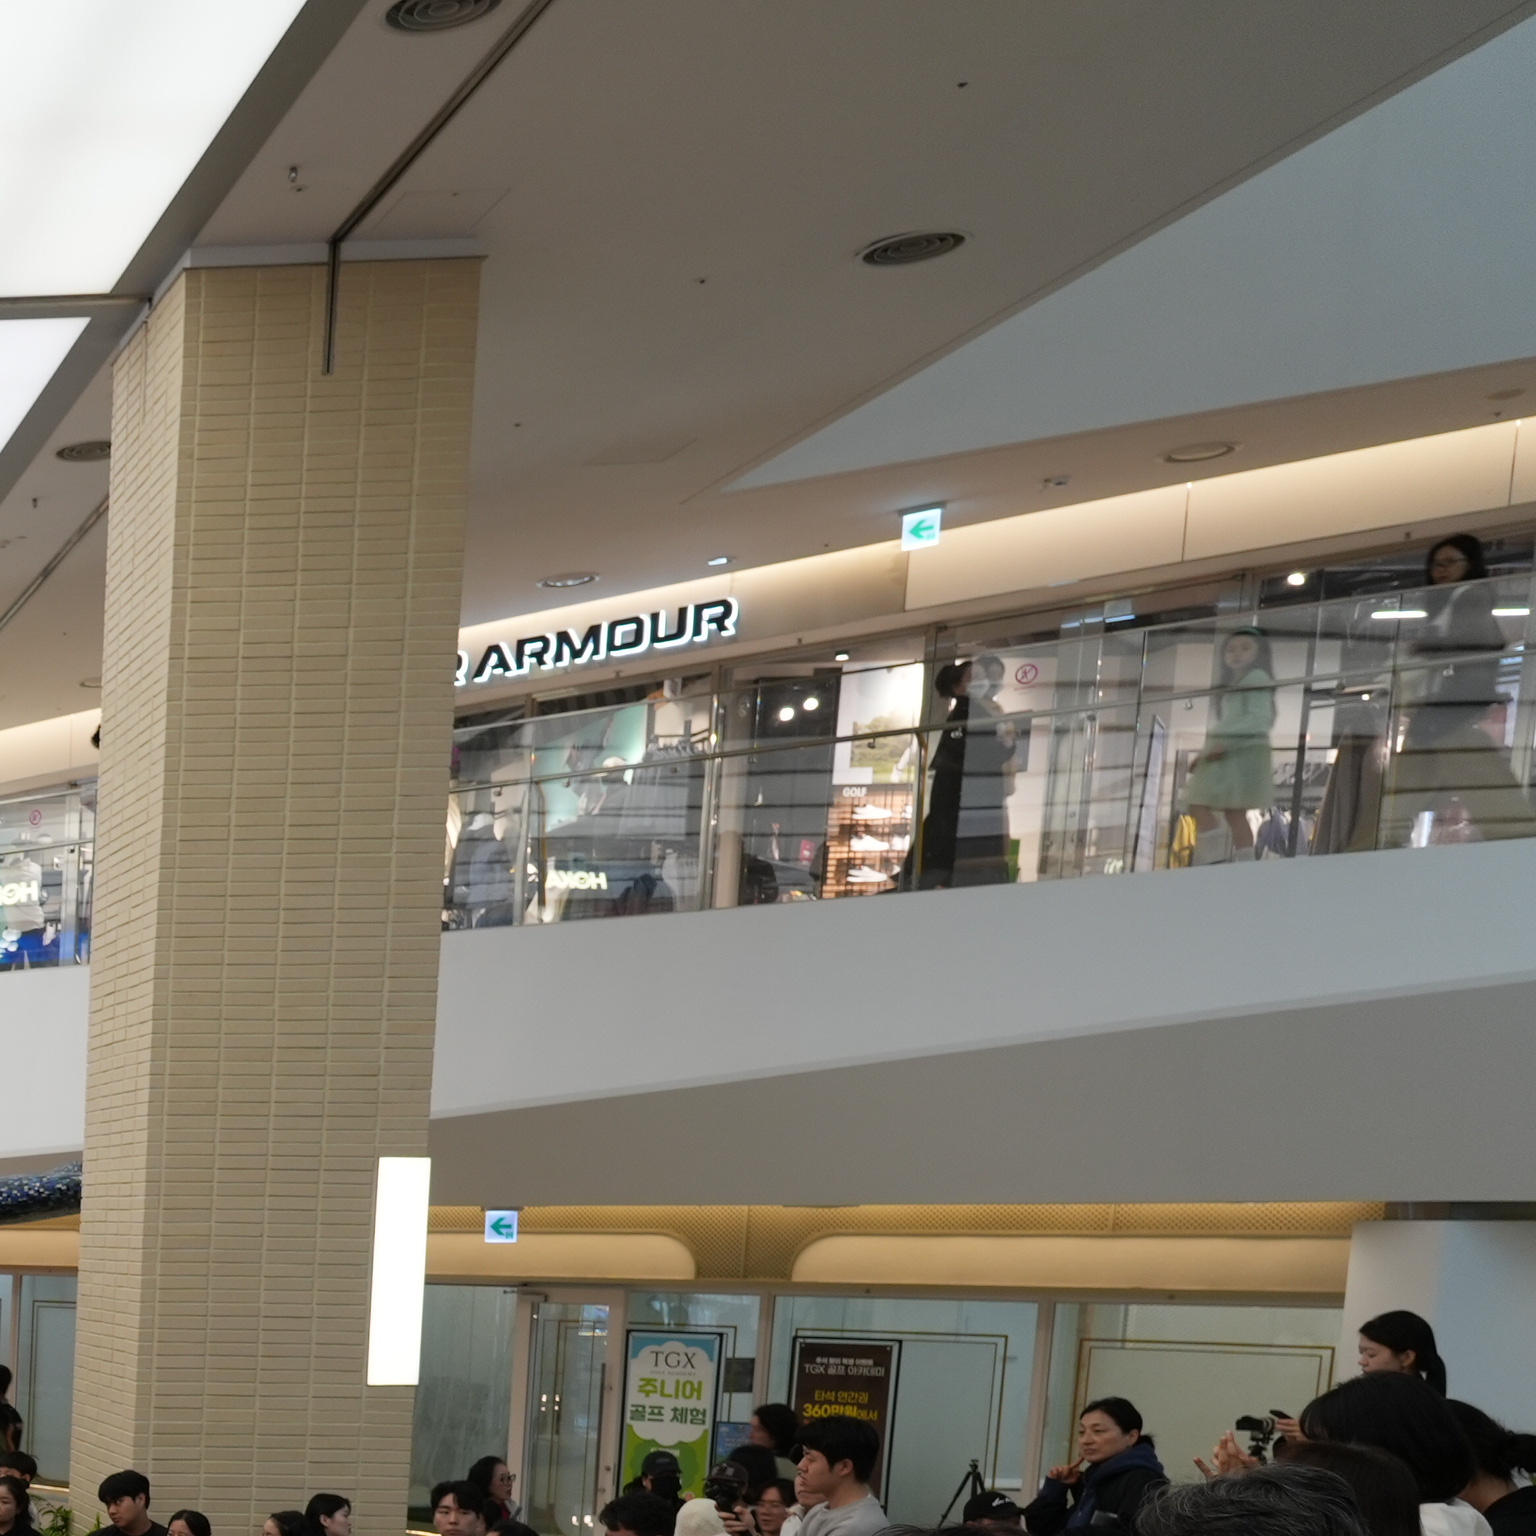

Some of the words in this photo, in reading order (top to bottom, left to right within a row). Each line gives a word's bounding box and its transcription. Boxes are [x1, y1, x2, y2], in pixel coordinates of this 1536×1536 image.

[472, 597, 739, 682] ARMOUR
[842, 787, 867, 797] GOLF
[650, 1351, 696, 1370] TGX
[804, 1364, 825, 1375] TGX
[827, 1364, 846, 1376] 골프
[847, 1365, 885, 1377] 아카데미
[638, 1378, 703, 1400] 주니어
[814, 1390, 834, 1401] 타석
[629, 1404, 664, 1423] 골프
[671, 1405, 707, 1425] 체험
